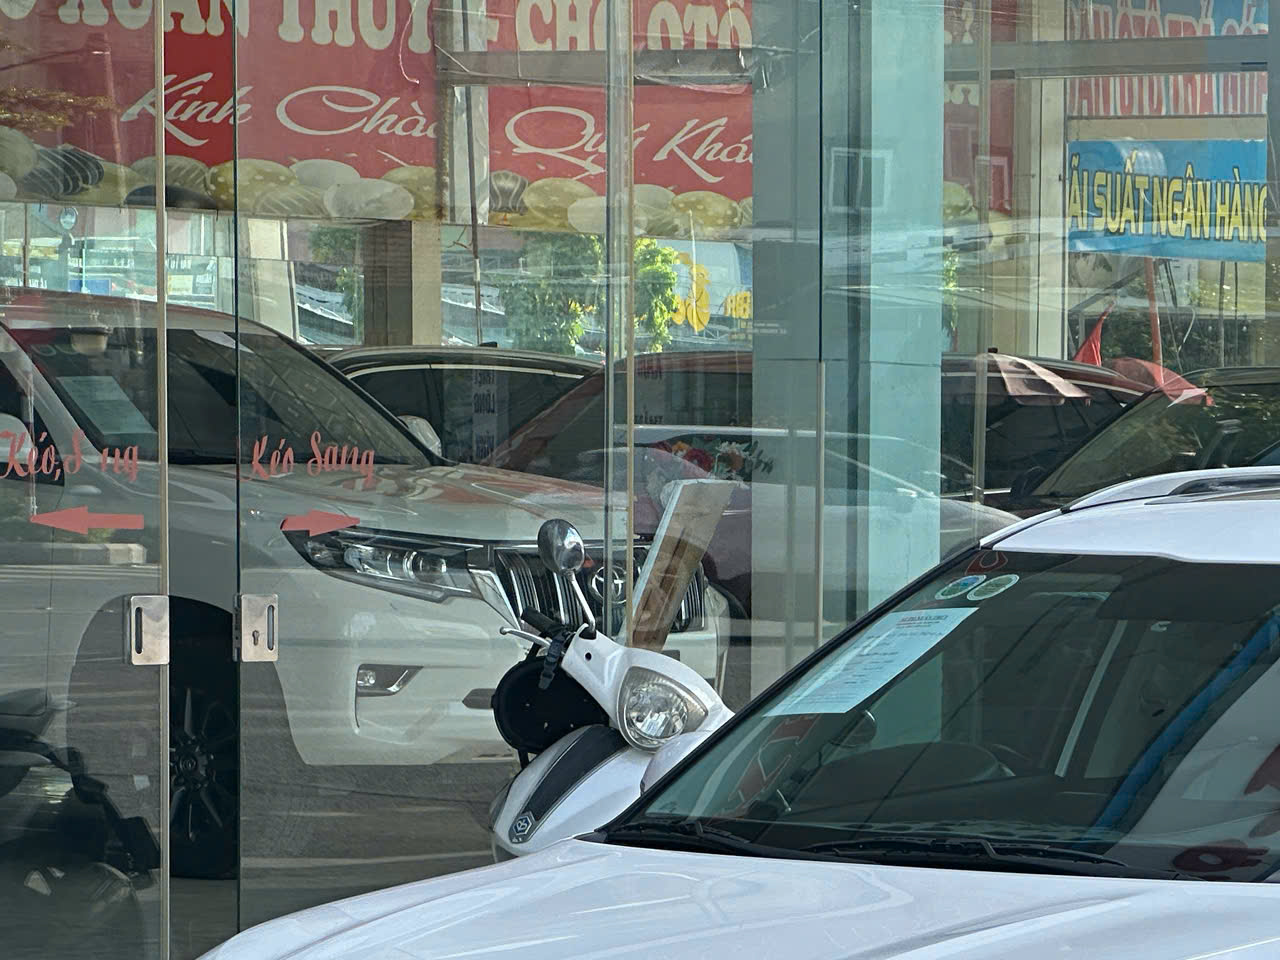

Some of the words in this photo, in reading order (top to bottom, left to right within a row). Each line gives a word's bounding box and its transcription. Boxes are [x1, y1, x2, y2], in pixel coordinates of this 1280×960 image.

[120, 72, 254, 147] Kính
[1067, 152, 1089, 232] ÃI
[1093, 149, 1150, 236] SUẤT
[1151, 163, 1211, 240] NGÂN
[307, 430, 375, 488] Sang
